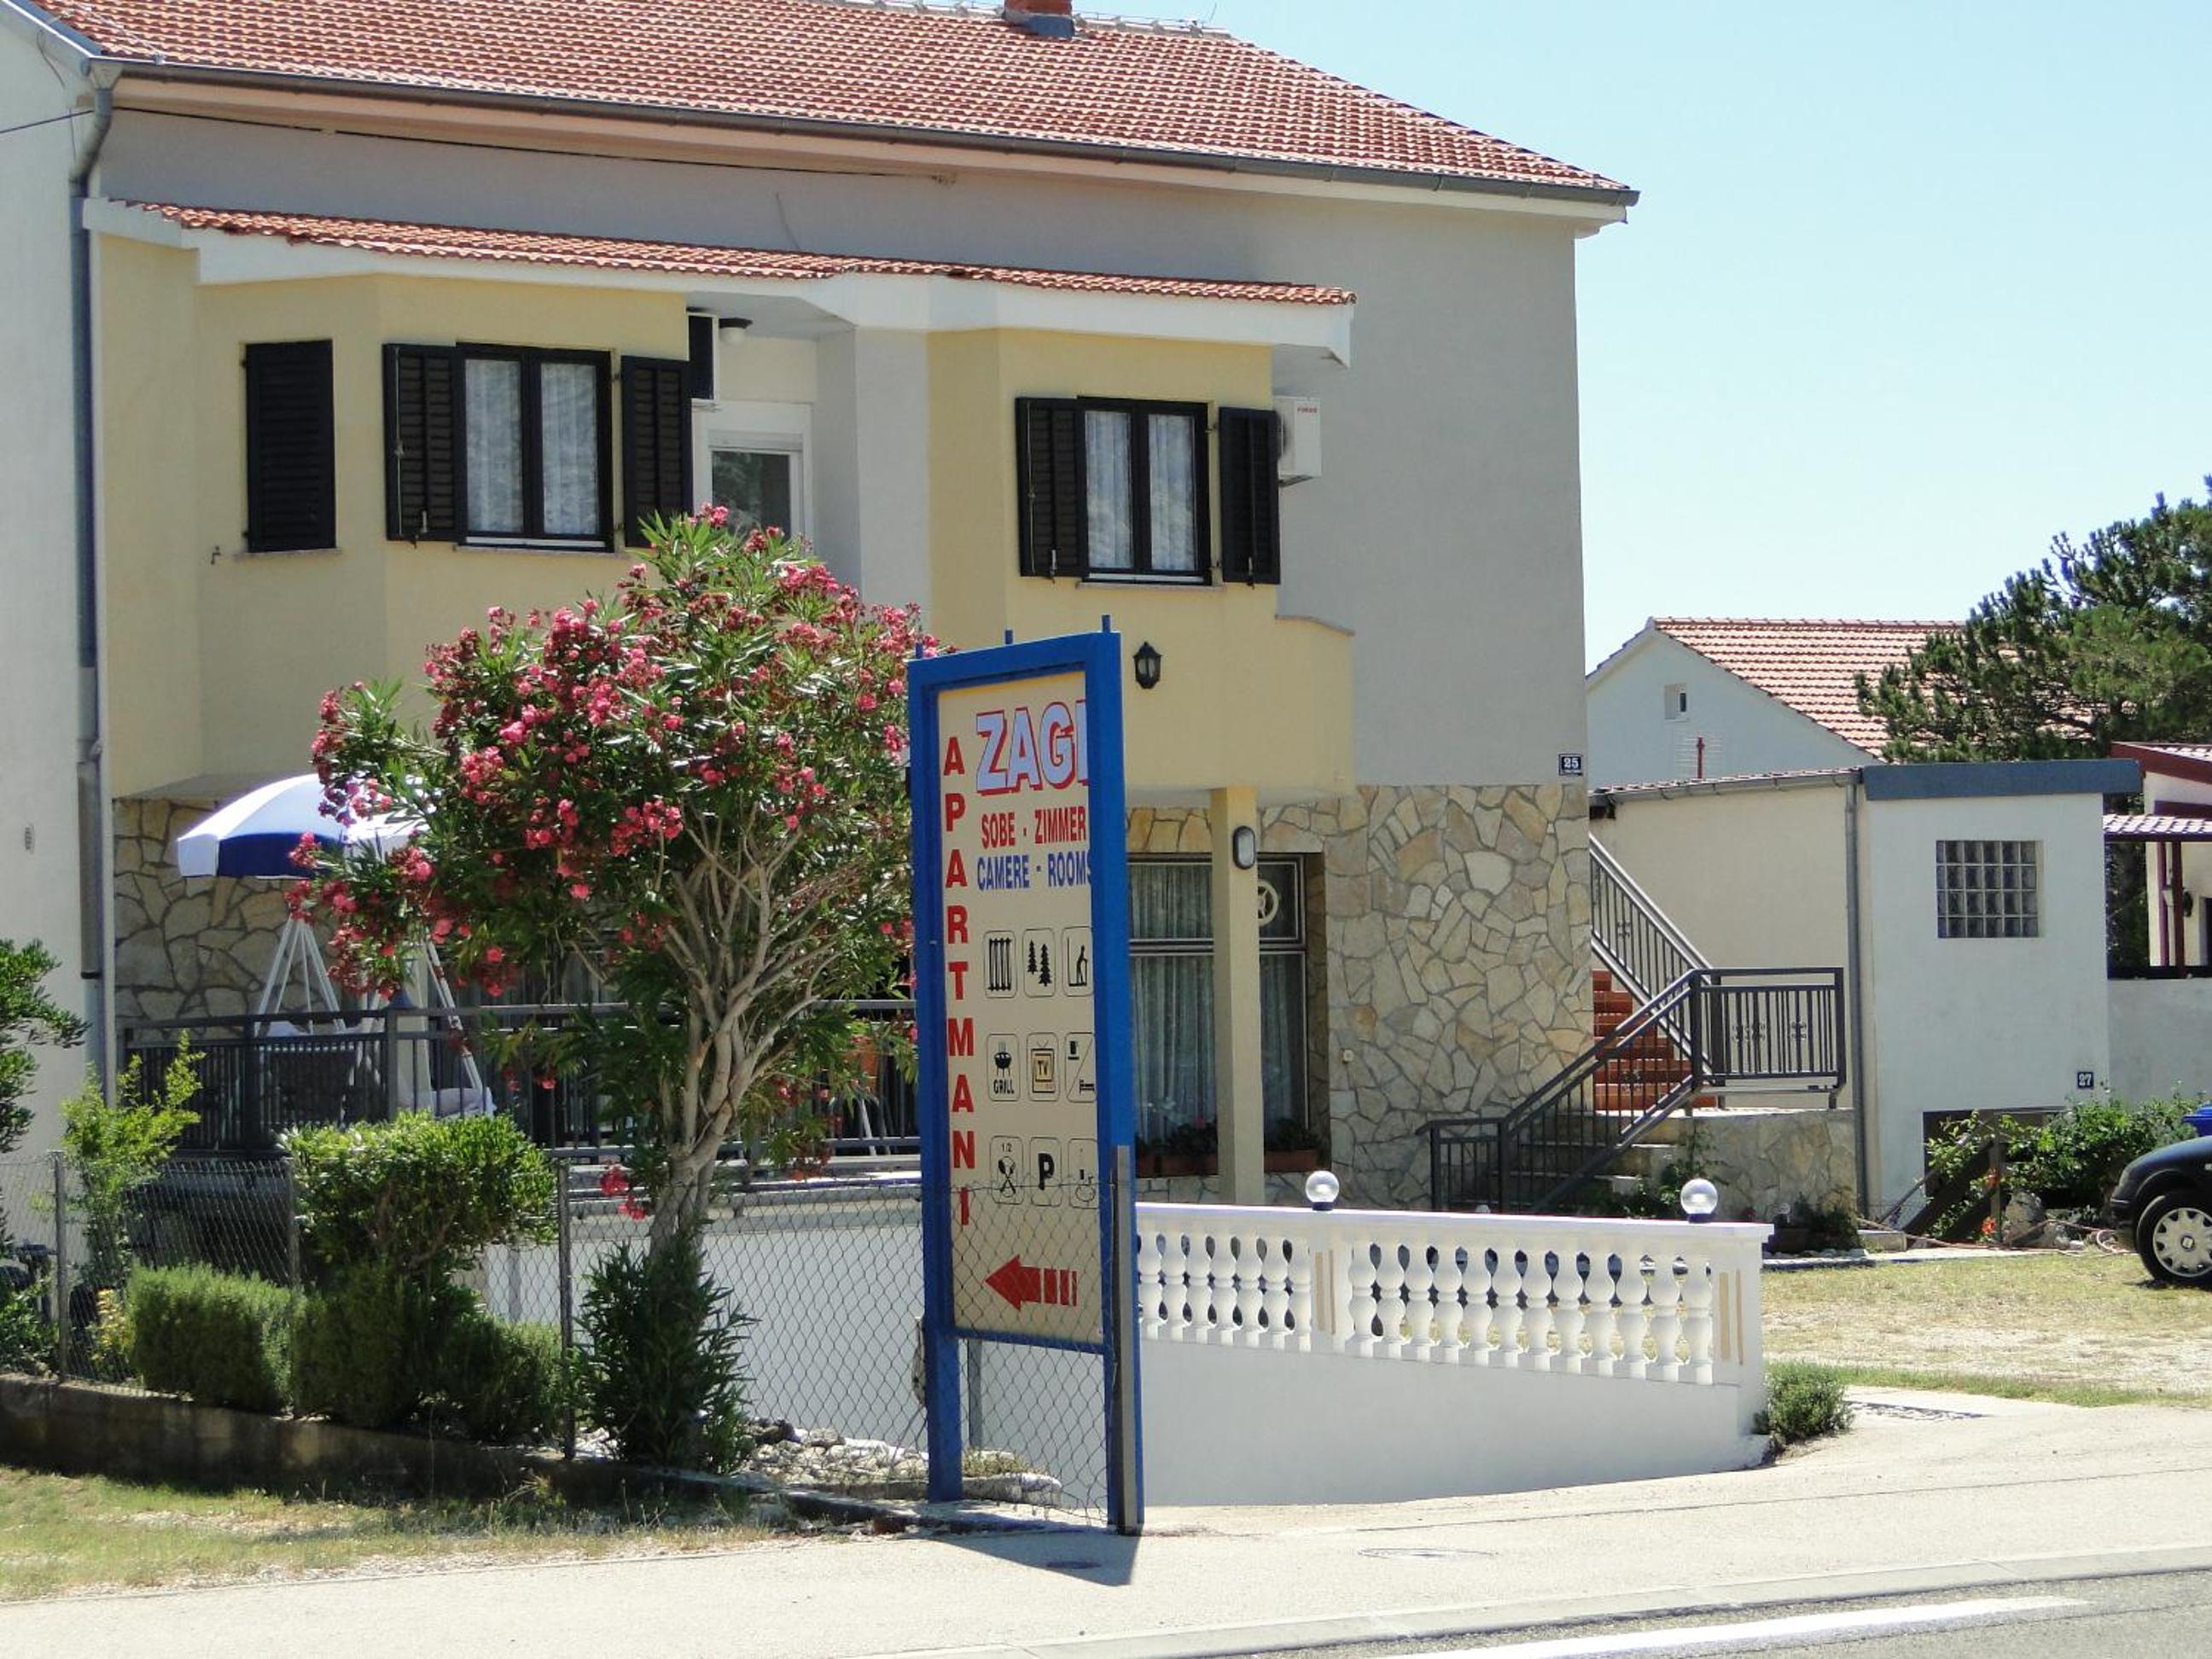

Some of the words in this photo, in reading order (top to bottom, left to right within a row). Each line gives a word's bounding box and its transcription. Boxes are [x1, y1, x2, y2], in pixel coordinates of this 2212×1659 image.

[1563, 757, 1579, 769] 25
[981, 812, 1016, 849] SOBE
[1034, 806, 1086, 844] ZIMMER
[976, 855, 1030, 890] CAMERE
[943, 736, 975, 1225] APARTMANI
[1038, 1060, 1049, 1075] TV
[993, 1079, 1015, 1094] GRILL
